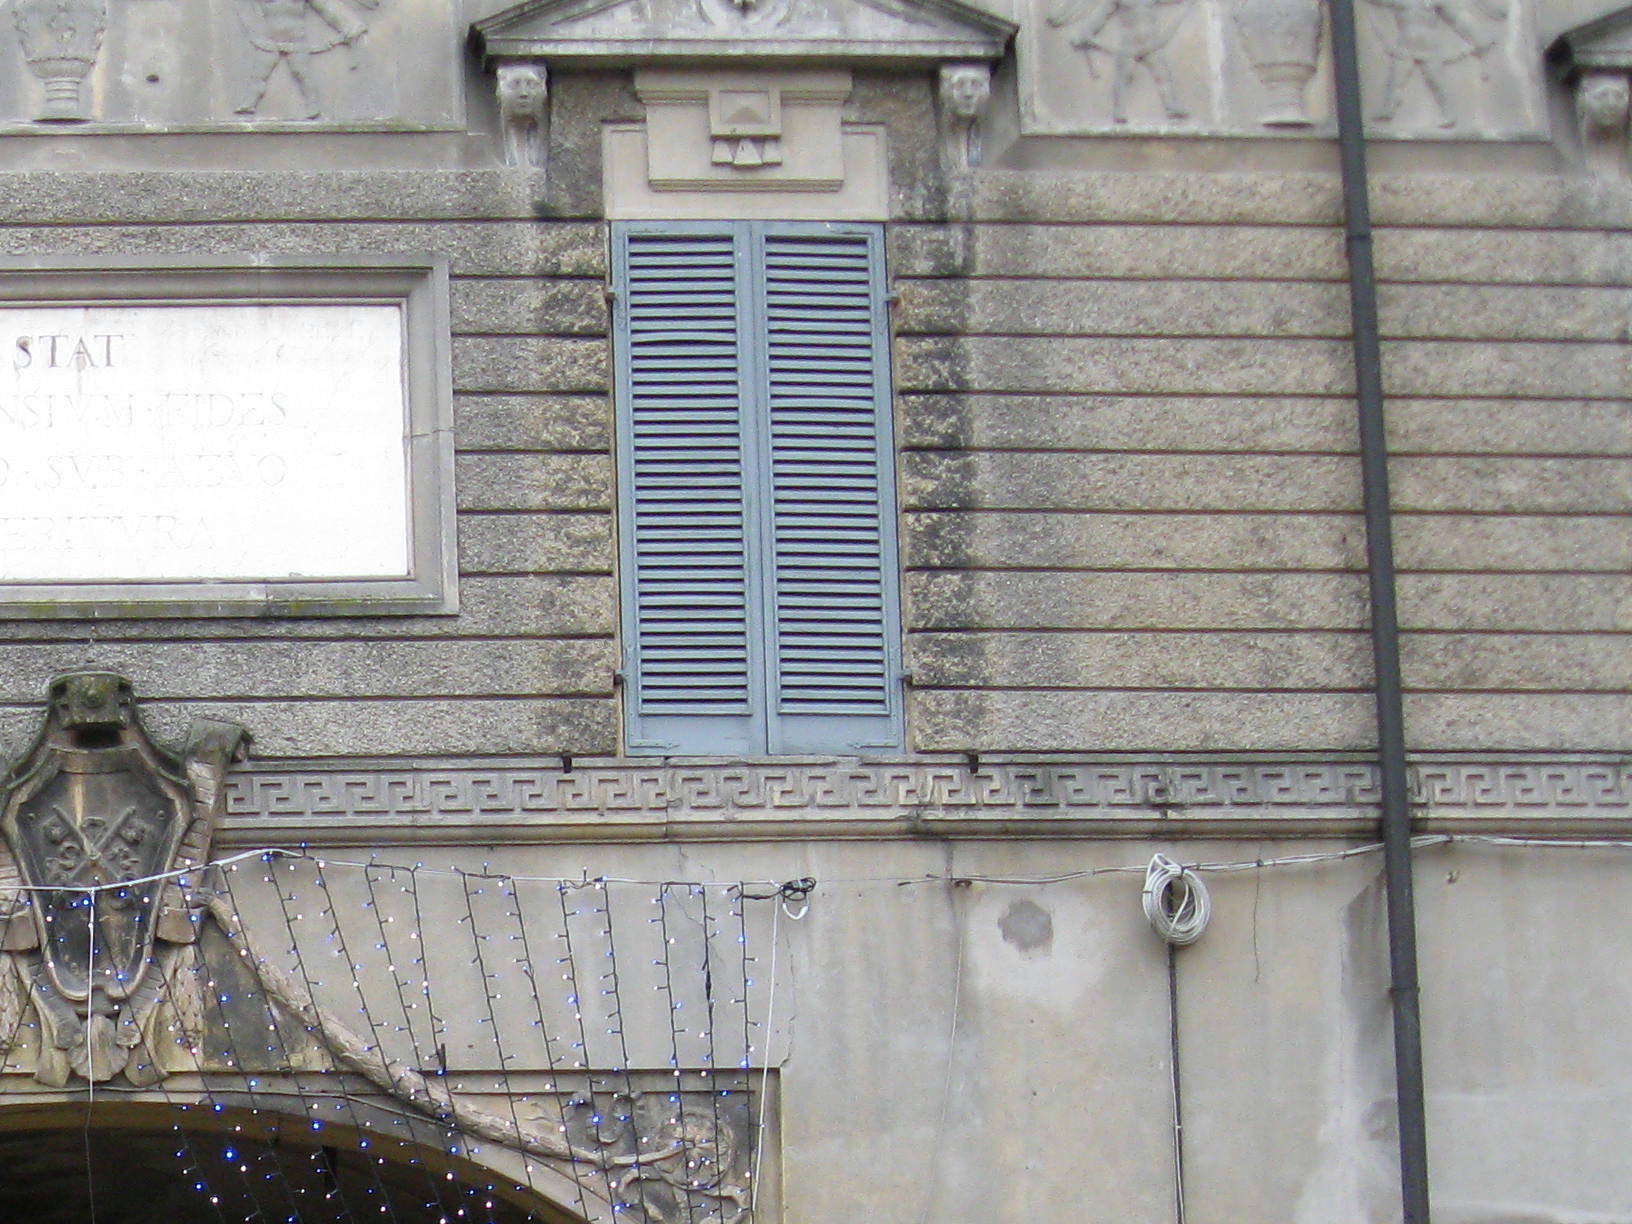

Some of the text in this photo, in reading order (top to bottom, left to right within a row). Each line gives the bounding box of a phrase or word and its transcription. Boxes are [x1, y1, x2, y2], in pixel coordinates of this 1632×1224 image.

[14, 334, 123, 368] STAT
[165, 392, 288, 430] FIDES
[46, 456, 126, 487] SVB
